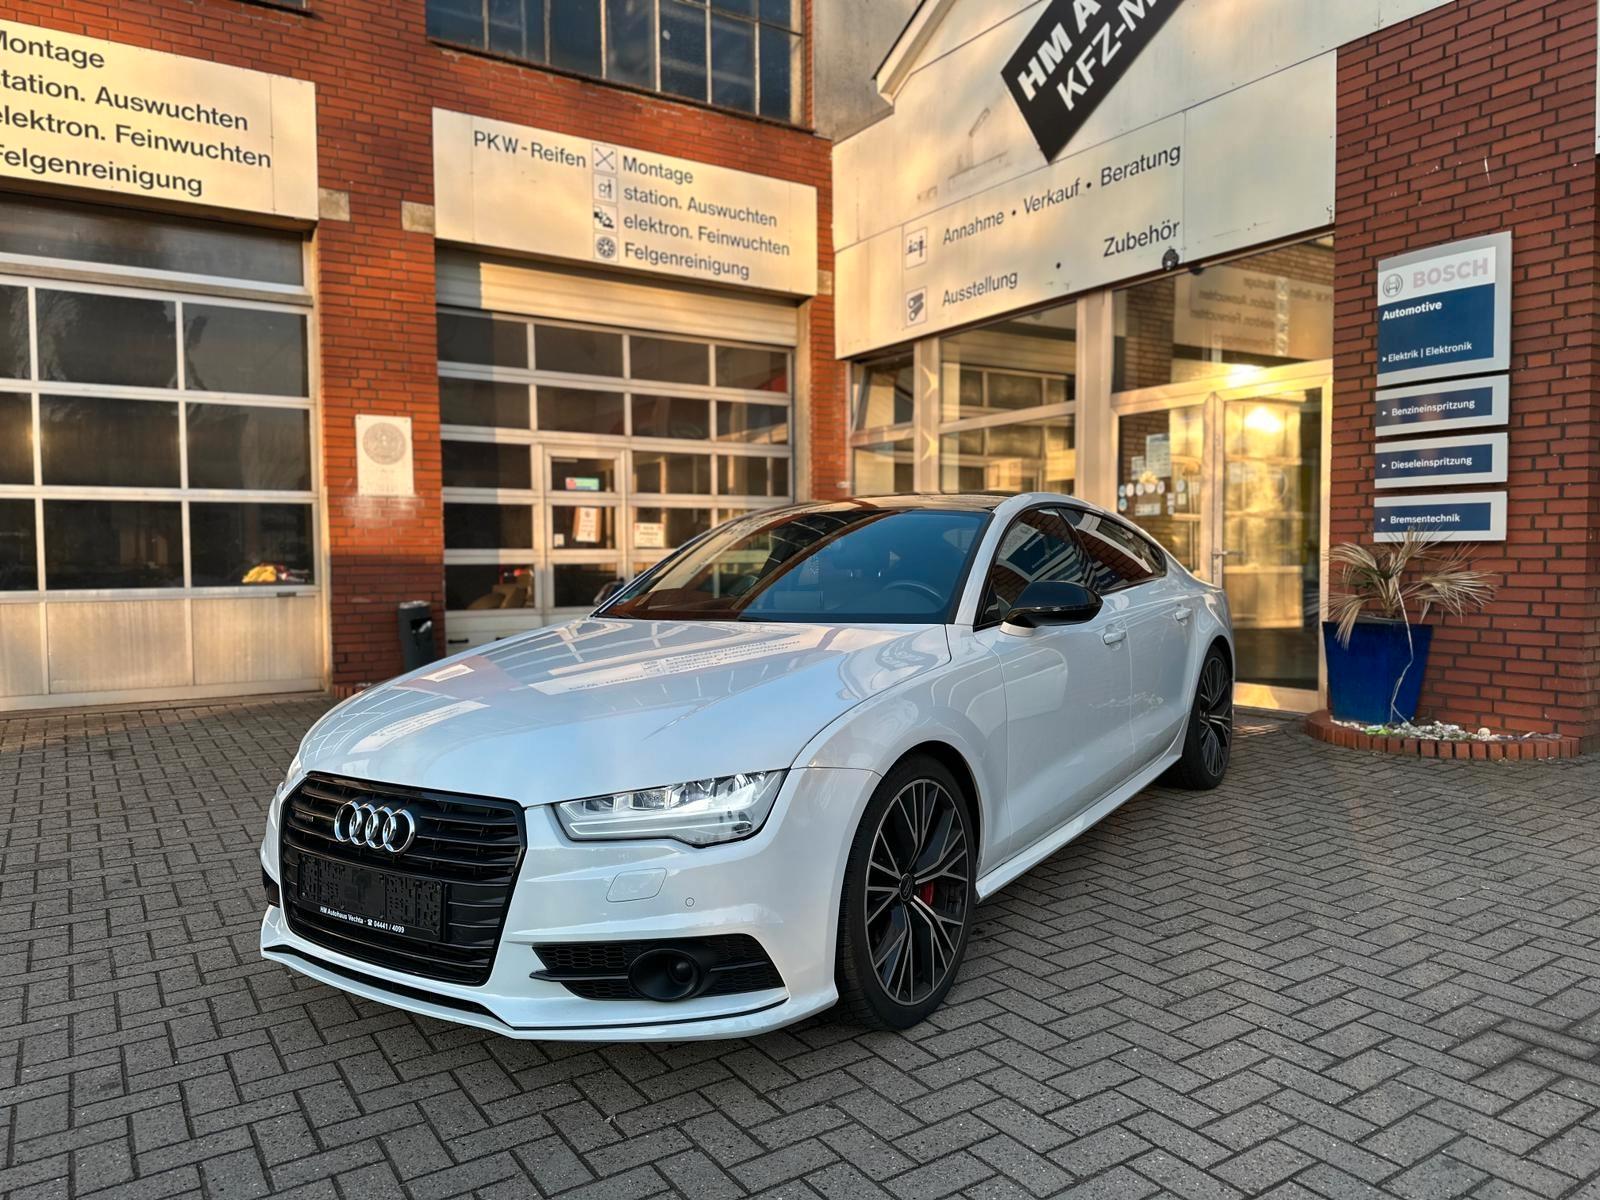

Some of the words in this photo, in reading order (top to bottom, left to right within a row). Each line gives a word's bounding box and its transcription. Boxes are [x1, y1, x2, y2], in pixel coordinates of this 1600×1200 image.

[1017, 22, 1073, 102] HM
[0, 69, 86, 103] tation.
[95, 86, 249, 131] Auswuchten
[0, 105, 106, 141] lektron.
[116, 124, 272, 168] Feinwuchten
[473, 131, 587, 168] PKW-Reifen
[623, 155, 693, 185] Montage
[623, 186, 683, 209] station.
[687, 196, 777, 227] Auswuchten
[943, 211, 1004, 245] Annahme
[1024, 177, 1080, 214] Verkauf
[1101, 146, 1181, 187] Beratung
[623, 214, 693, 239] elektron.
[698, 226, 790, 257] Feinwuchten
[624, 243, 750, 280] Felgenreinigung
[942, 272, 1018, 307] Ausstellung
[1103, 219, 1180, 257] Zubehör
[1413, 258, 1488, 288] BOSCH
[1382, 301, 1442, 320] Automotive
[1388, 349, 1419, 363] Elektrik
[1425, 341, 1472, 356] Elektronik
[1391, 400, 1475, 416] Benzineinspritzung
[1391, 457, 1472, 469] Dieseleinspritzung
[1390, 513, 1460, 524] Bremsentechnik
[327, 908, 347, 920] Autohaus
[348, 914, 364, 924] Vechta
[374, 920, 388, 930] 04441
